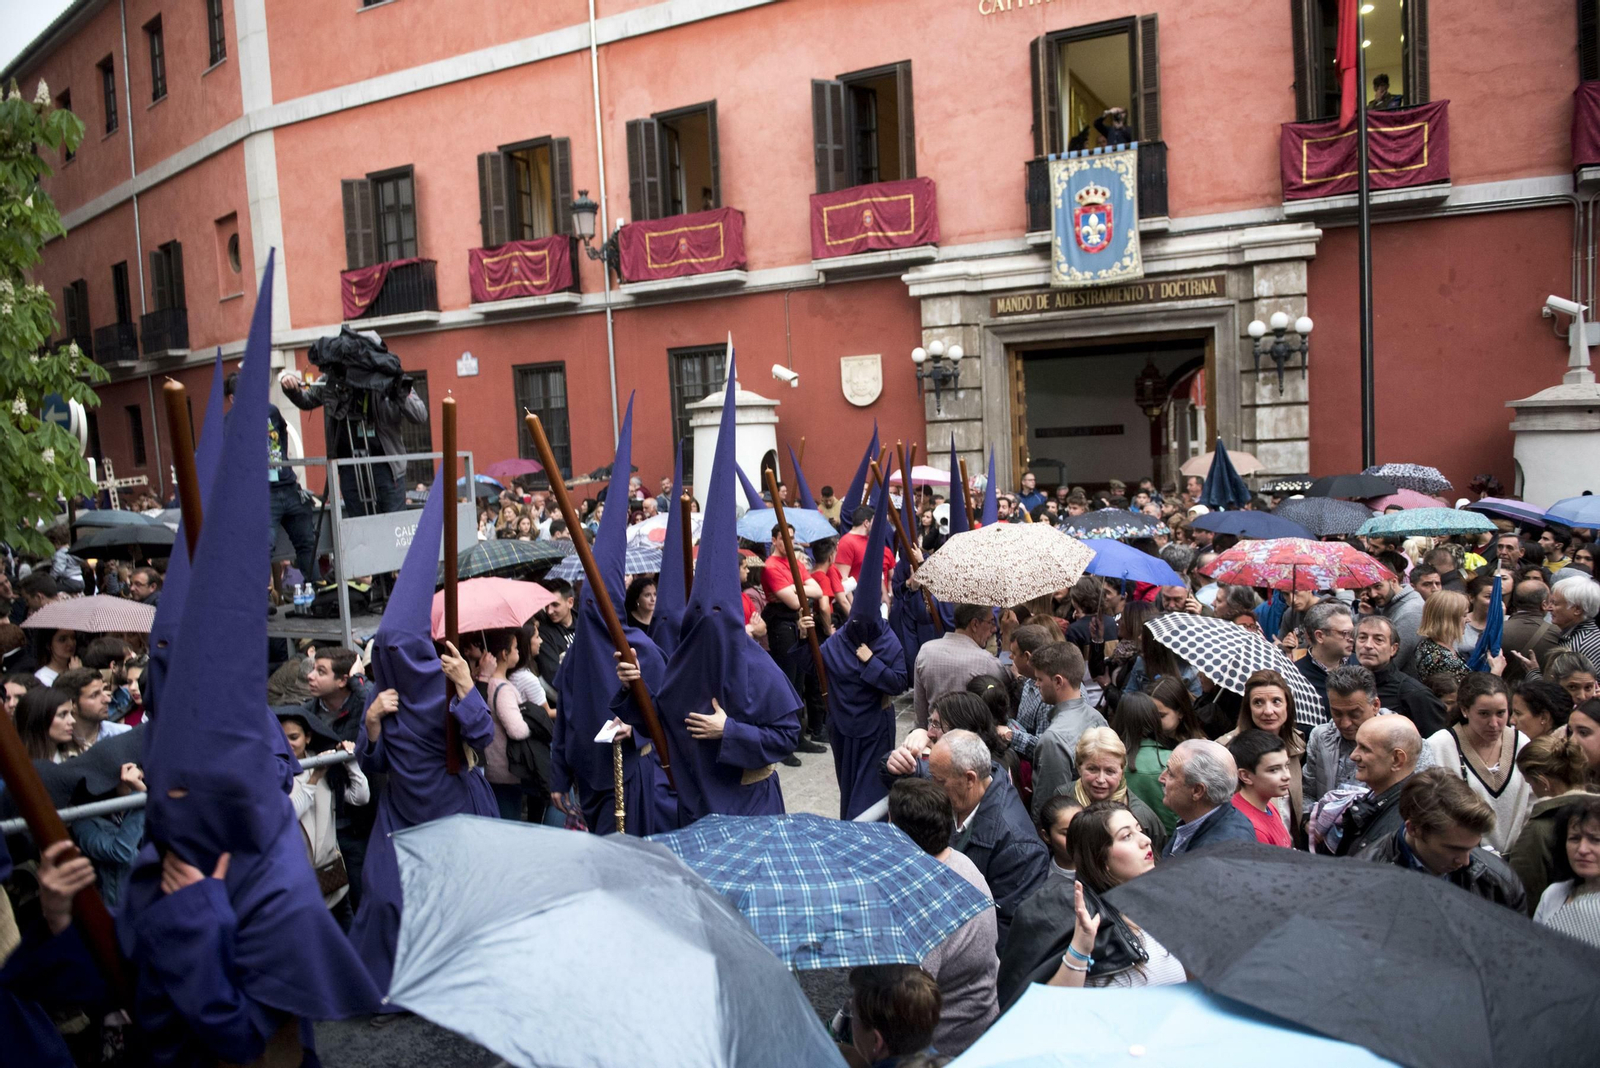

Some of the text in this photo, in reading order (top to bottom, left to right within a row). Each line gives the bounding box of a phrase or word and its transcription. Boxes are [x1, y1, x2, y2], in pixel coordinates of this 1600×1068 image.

[997, 278, 1217, 314] MANDO DE ADIESTRAMIENTO Y DOCTRINA
[394, 523, 419, 538] CALE
